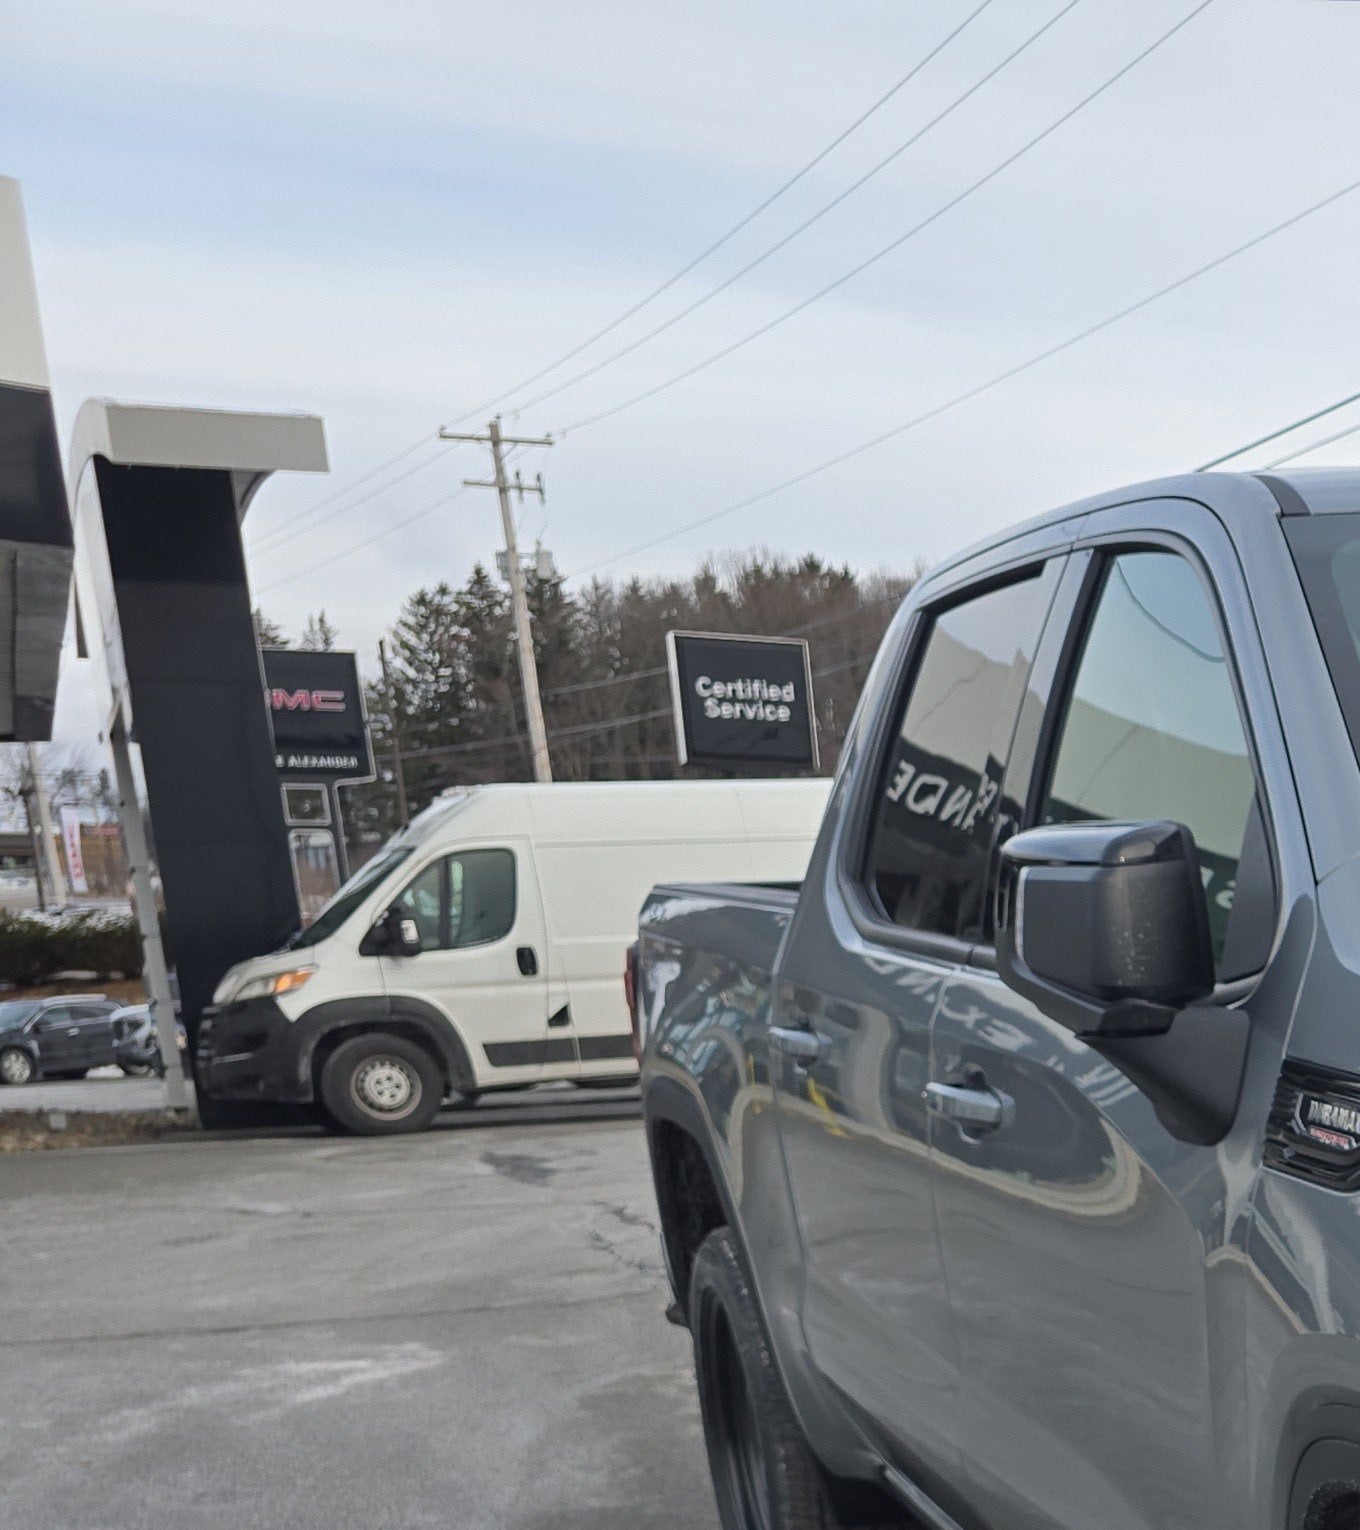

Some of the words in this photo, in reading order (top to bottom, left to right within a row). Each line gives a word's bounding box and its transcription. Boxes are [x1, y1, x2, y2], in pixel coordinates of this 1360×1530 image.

[271, 688, 347, 712] MC
[695, 675, 796, 703] Certified
[704, 697, 791, 722] Service
